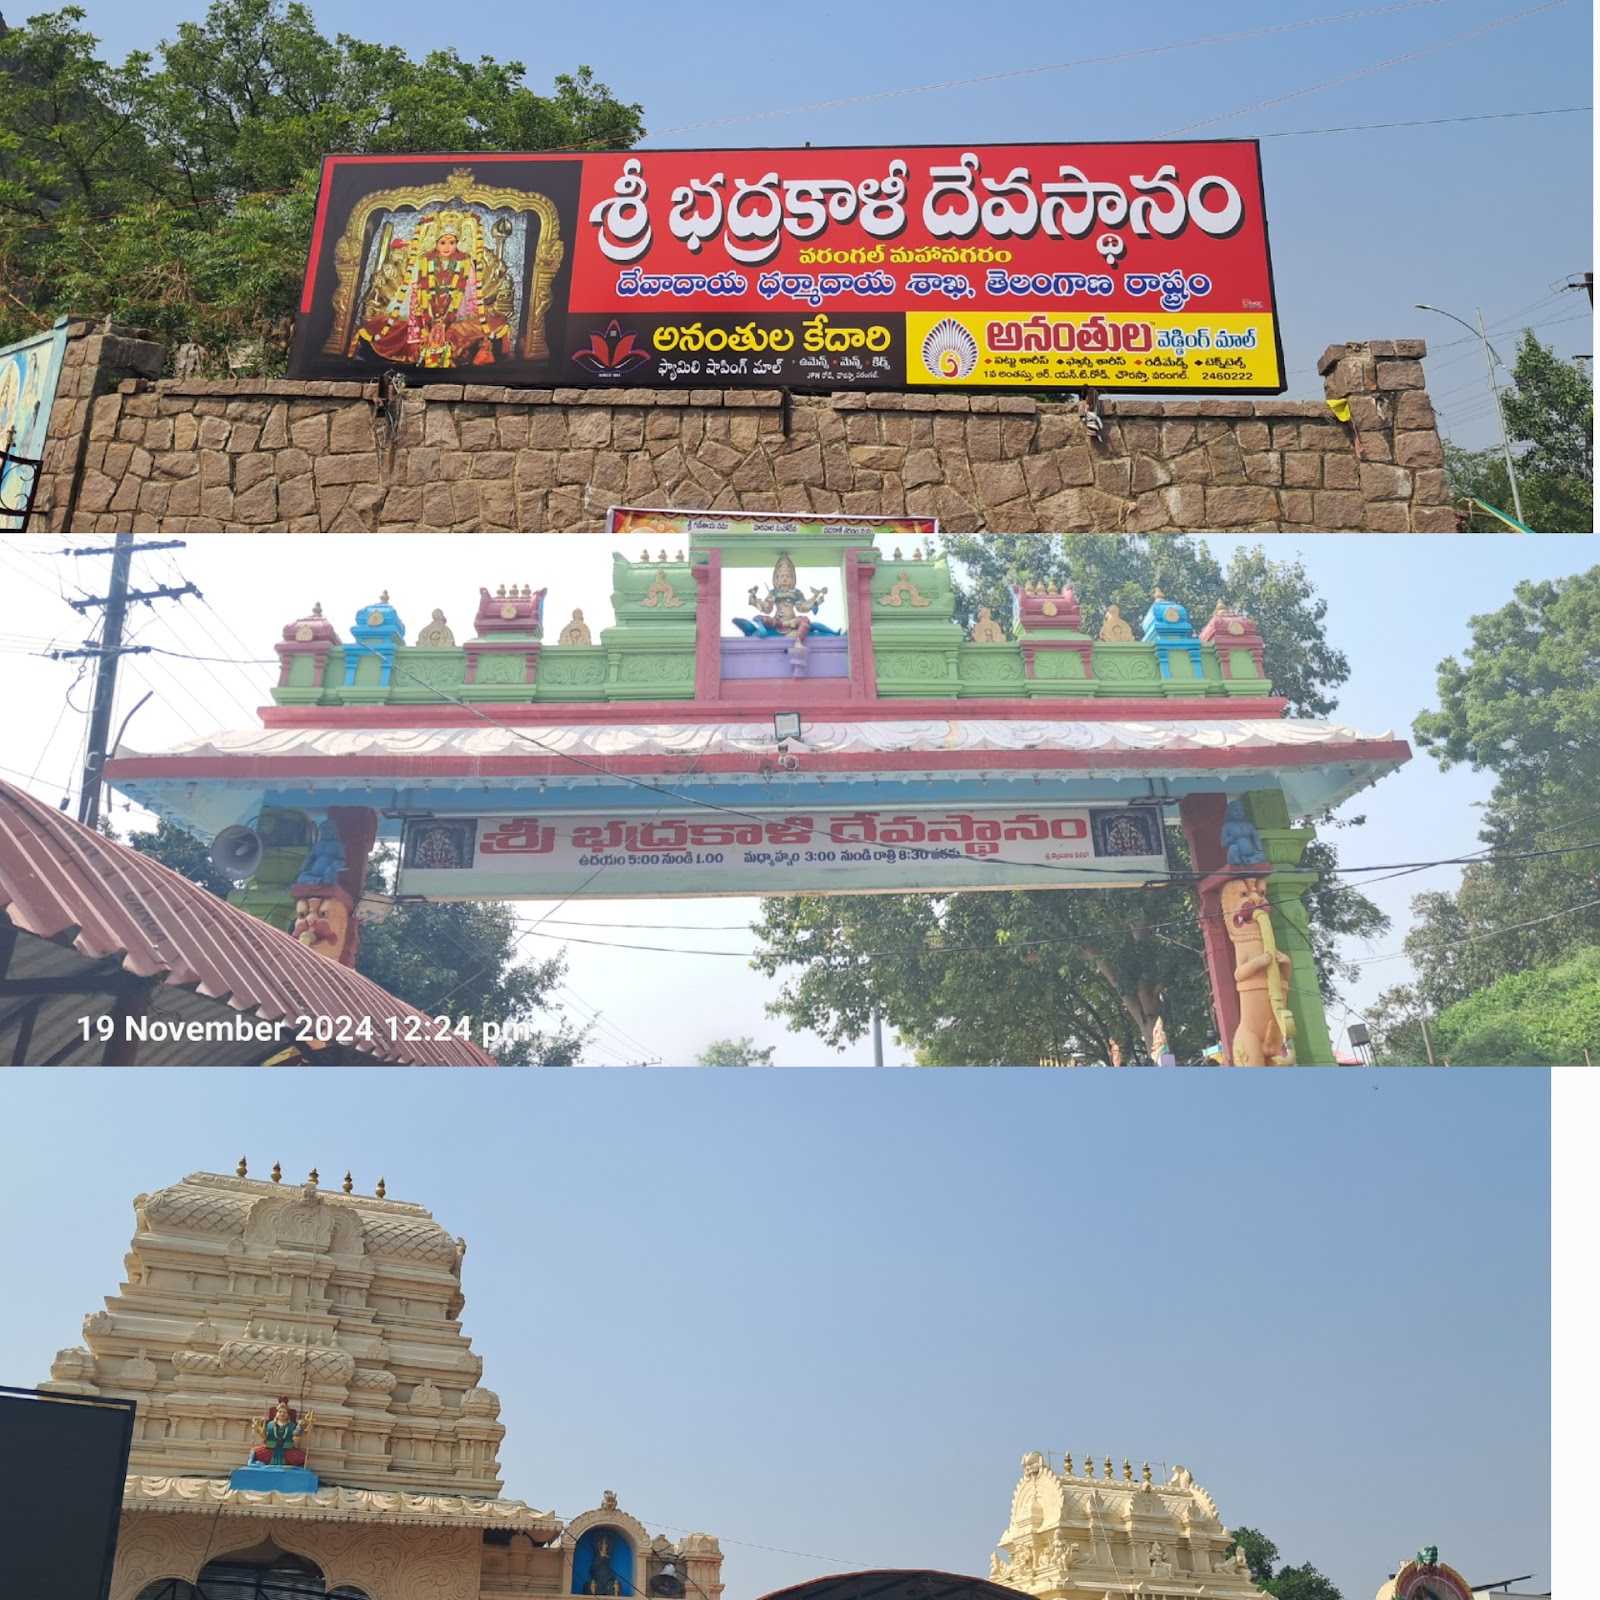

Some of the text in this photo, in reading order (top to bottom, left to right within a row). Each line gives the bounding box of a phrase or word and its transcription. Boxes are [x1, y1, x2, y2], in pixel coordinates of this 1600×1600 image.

[589, 152, 1242, 264] శ్రీ భద్రకాళీ దేవస్థానం
[799, 244, 1012, 264] వరంగల్ మహానగరం
[617, 267, 747, 297] దేవాదాయ
[757, 269, 895, 307] ధర్మాదాయ
[985, 269, 1114, 296] తెలంగాణ
[1124, 270, 1211, 311] రాష్ట్రం
[653, 313, 891, 352] అనంతుల కేదారి
[986, 315, 1152, 354] అనంతుల
[1157, 328, 1210, 356] వెడ్డింగ్
[1215, 328, 1257, 348] మాల్
[706, 358, 748, 376] షాపింగ్
[753, 358, 784, 374] మాల్
[1202, 372, 1253, 380] 2460222
[479, 818, 555, 854] శ్రీ
[830, 812, 1088, 856] దేవస్థానం
[579, 851, 724, 866] ఉదయం 5:00 నుండి 1.00
[744, 850, 800, 867] మధ్యాహ్నం
[805, 851, 836, 862] 3:00
[840, 849, 872, 862] నుండి
[873, 849, 896, 864] రాత్రి
[899, 849, 928, 861] 8:30
